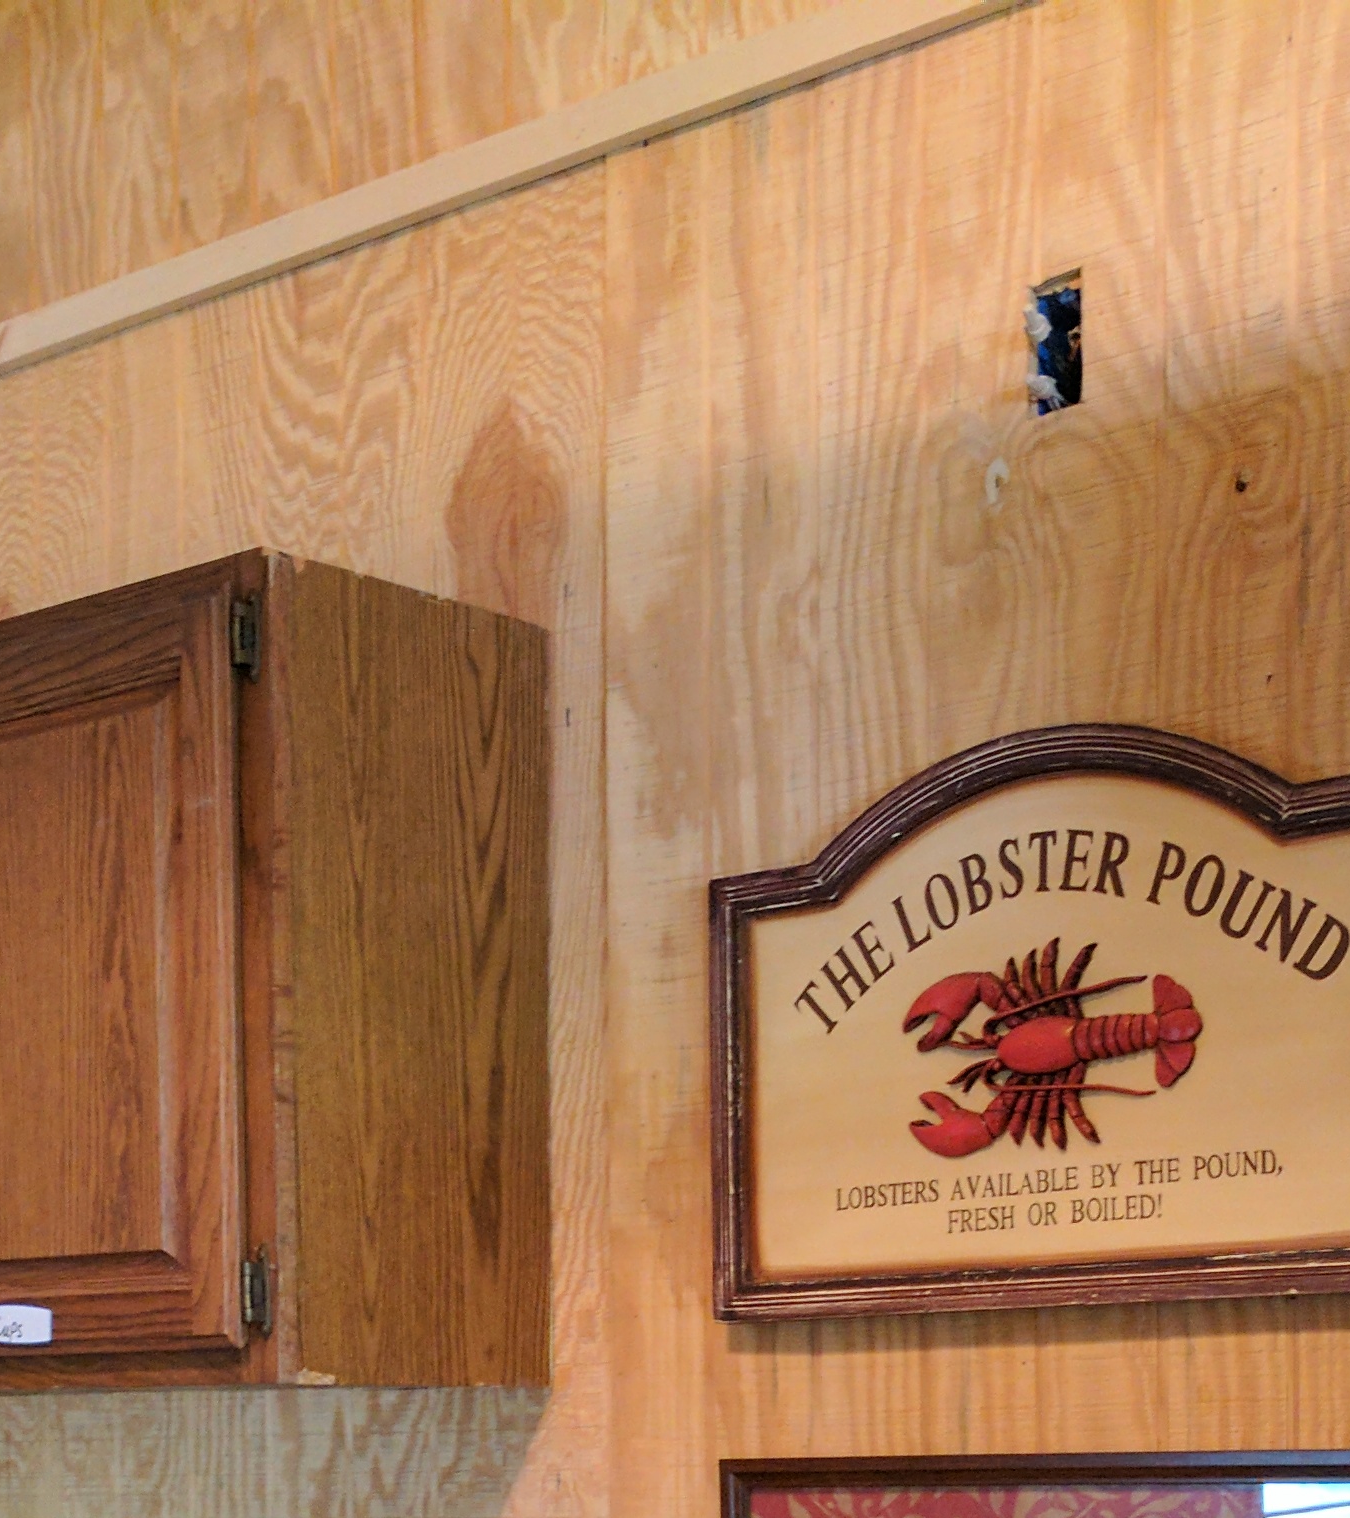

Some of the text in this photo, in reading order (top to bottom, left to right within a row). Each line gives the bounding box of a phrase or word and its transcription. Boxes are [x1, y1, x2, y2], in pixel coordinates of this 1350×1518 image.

[793, 829, 1350, 1035] THE LOBSTER POUND
[835, 1149, 1283, 1211] LOBSTERS AVAILABLE BY THE POUND,
[947, 1193, 1164, 1234] FRESH OR BOILED!
